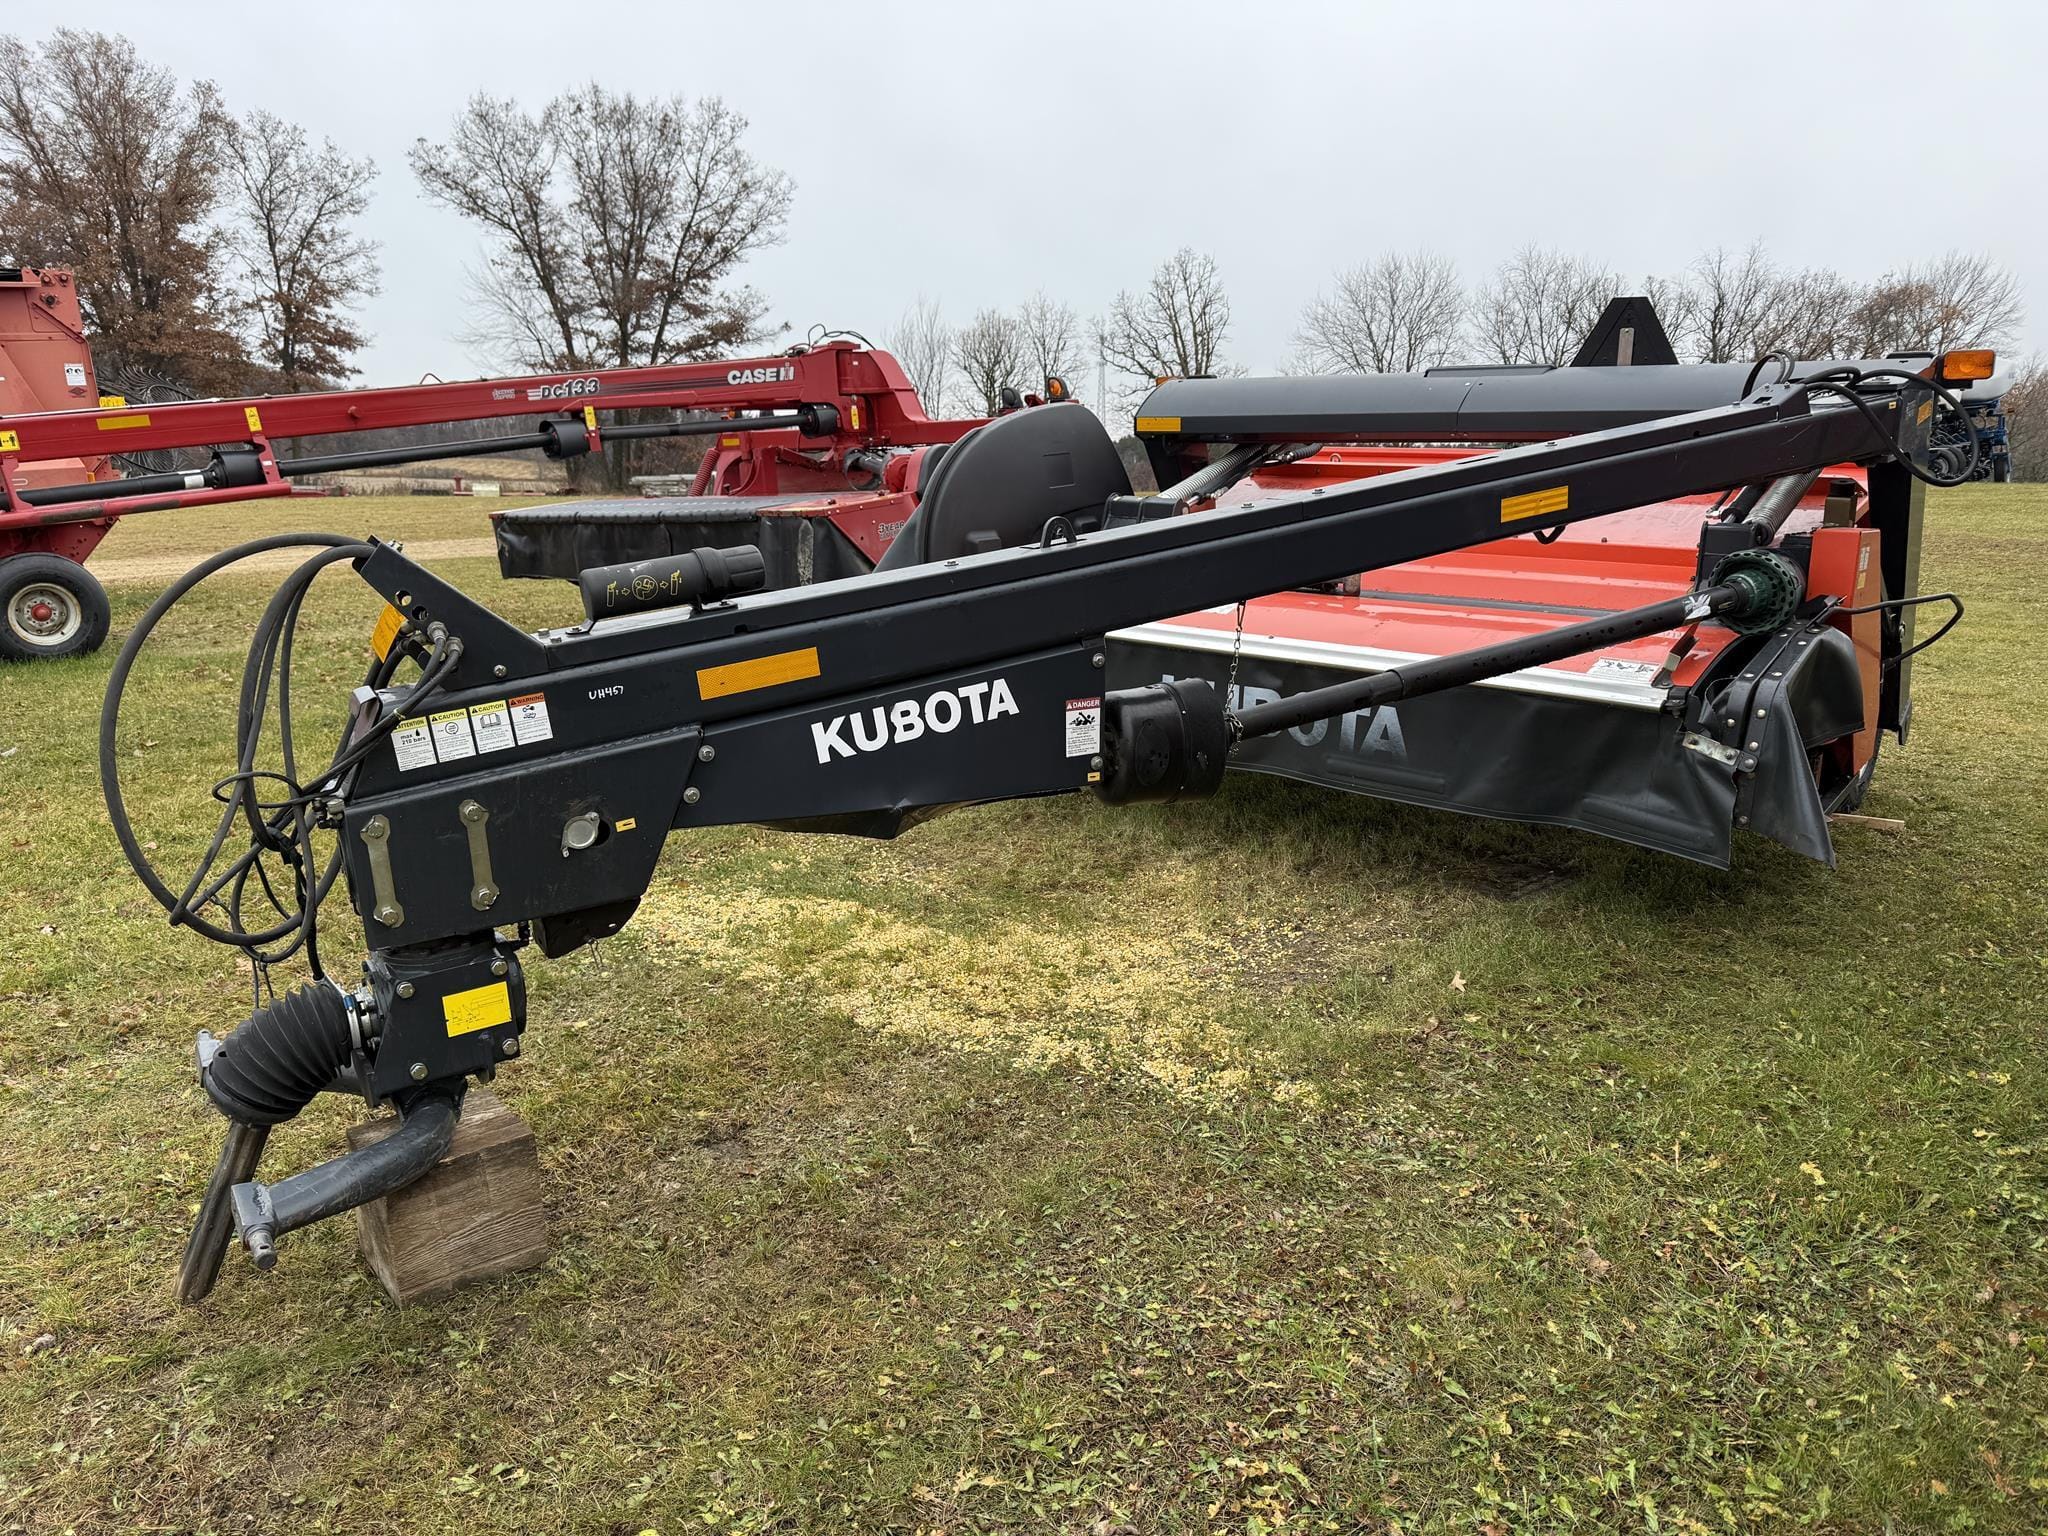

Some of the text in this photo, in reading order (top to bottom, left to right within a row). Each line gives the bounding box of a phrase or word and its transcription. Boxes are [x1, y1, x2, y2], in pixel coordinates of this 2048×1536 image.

[727, 367, 778, 385] CASE
[540, 377, 600, 399] DC133
[588, 685, 624, 700] UH457
[517, 694, 544, 704] WARNING
[1072, 699, 1100, 708] DANGER
[478, 703, 504, 712] CAUTION
[438, 711, 465, 720] CAUTION
[810, 678, 1020, 764] KUBOTA
